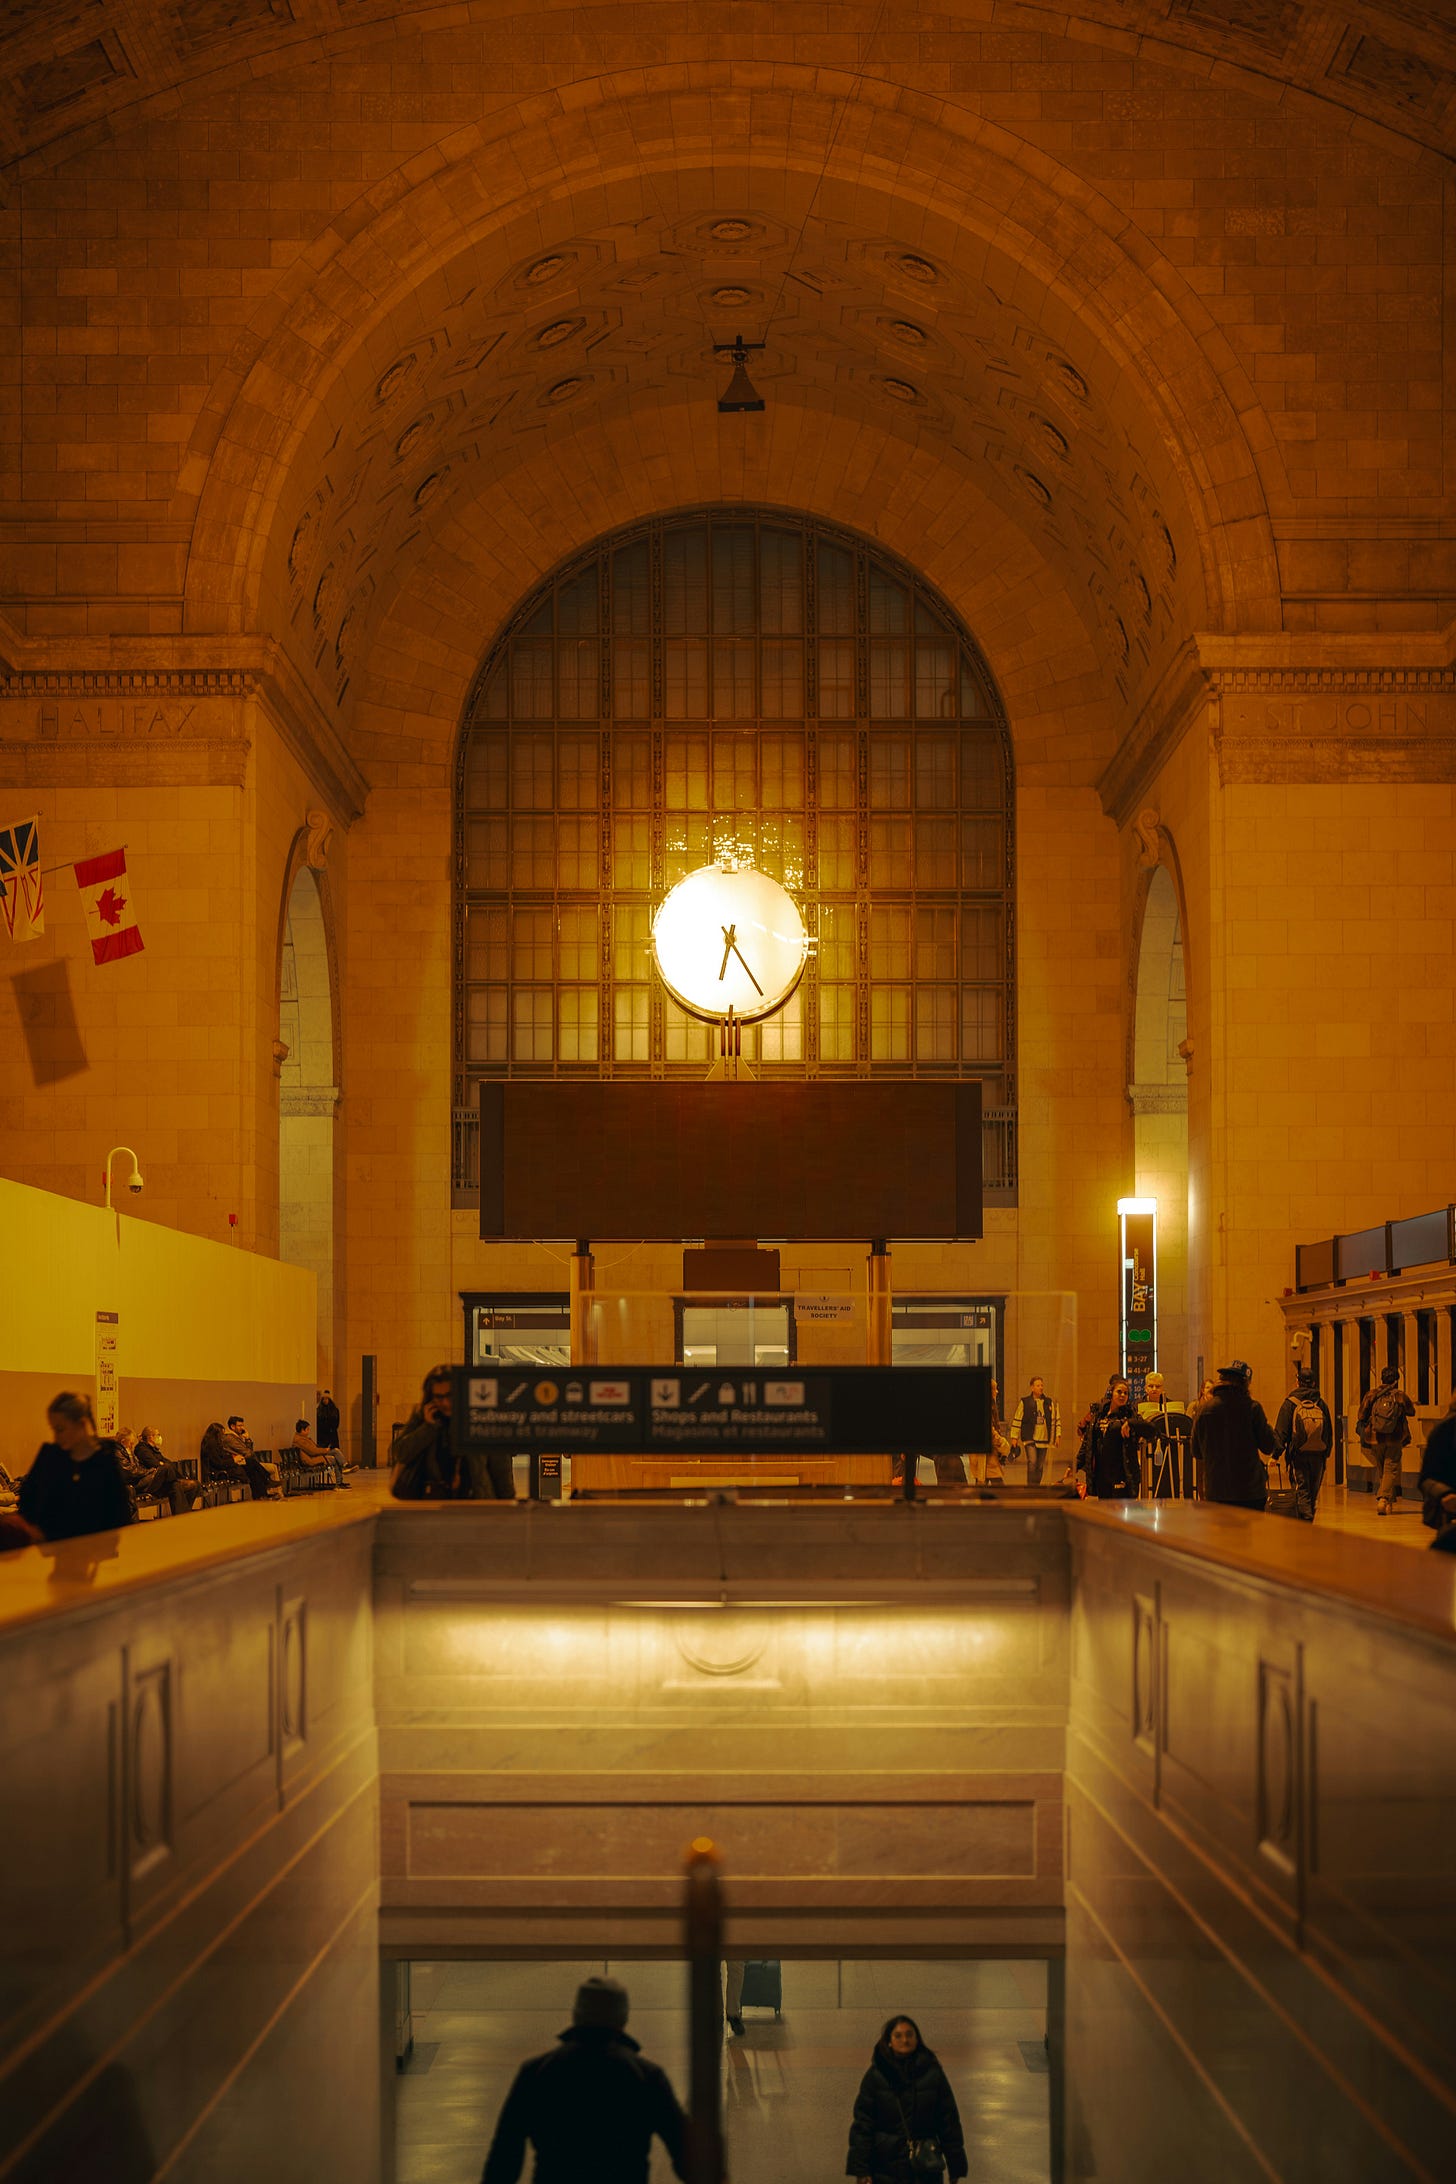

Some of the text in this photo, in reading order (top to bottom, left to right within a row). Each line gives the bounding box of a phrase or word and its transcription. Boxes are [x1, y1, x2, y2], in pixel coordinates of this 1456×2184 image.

[40, 704, 197, 734] HALIFAX
[1265, 703, 1429, 731] ST JOHN
[1133, 1282, 1146, 1312] BAY
[469, 1409, 635, 1425] Subway and streetcars
[651, 1409, 818, 1425] Shops and Restaurants
